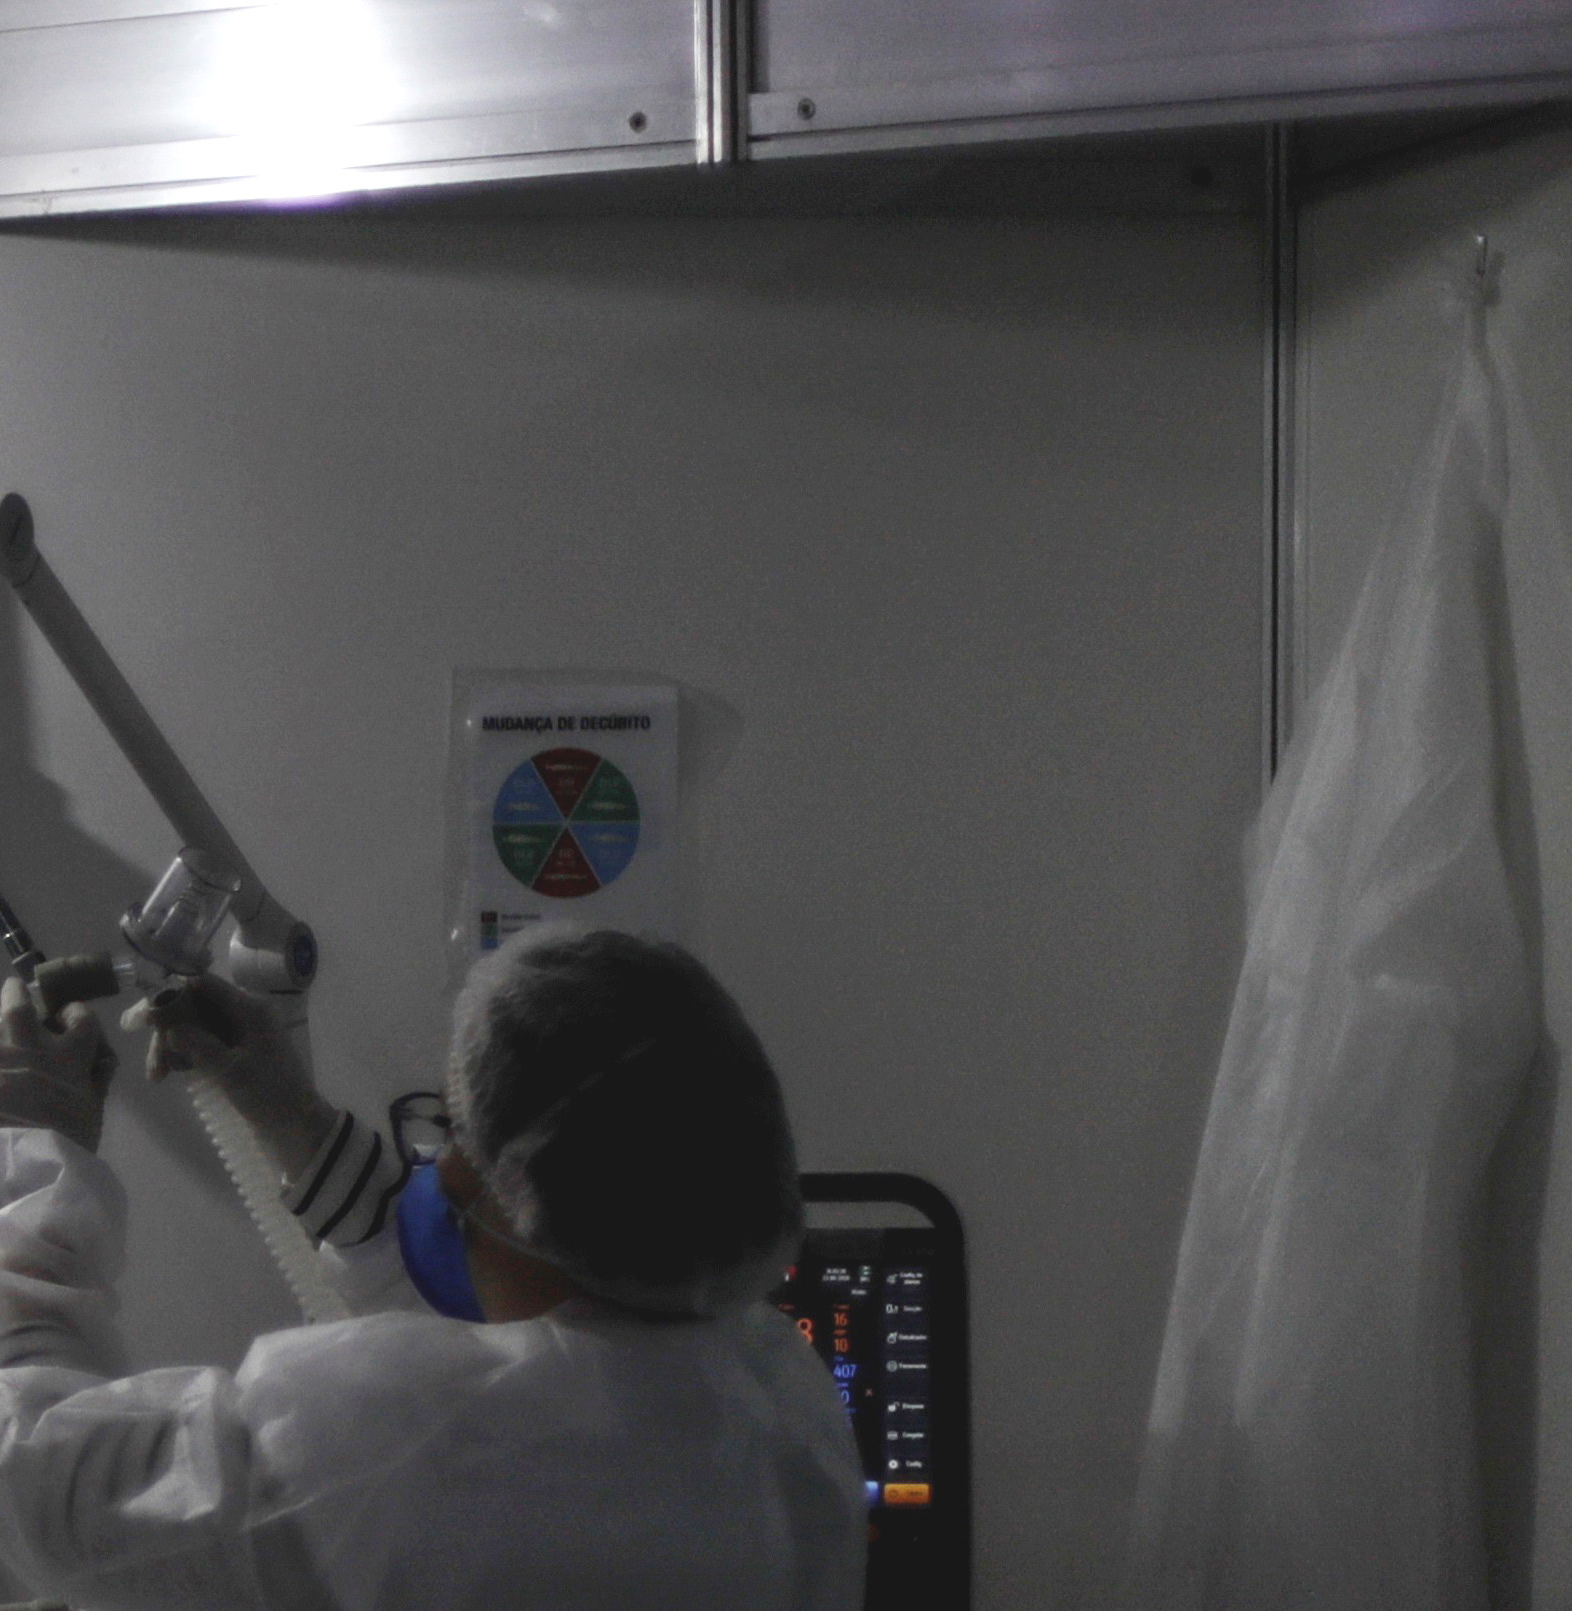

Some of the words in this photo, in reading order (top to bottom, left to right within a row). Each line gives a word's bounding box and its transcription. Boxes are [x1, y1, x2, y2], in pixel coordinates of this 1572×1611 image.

[482, 715, 552, 735] MUDANÇA
[558, 715, 575, 730] DE
[834, 1312, 847, 1326] 16
[834, 1338, 849, 1353] 10
[833, 1364, 857, 1378] 407
